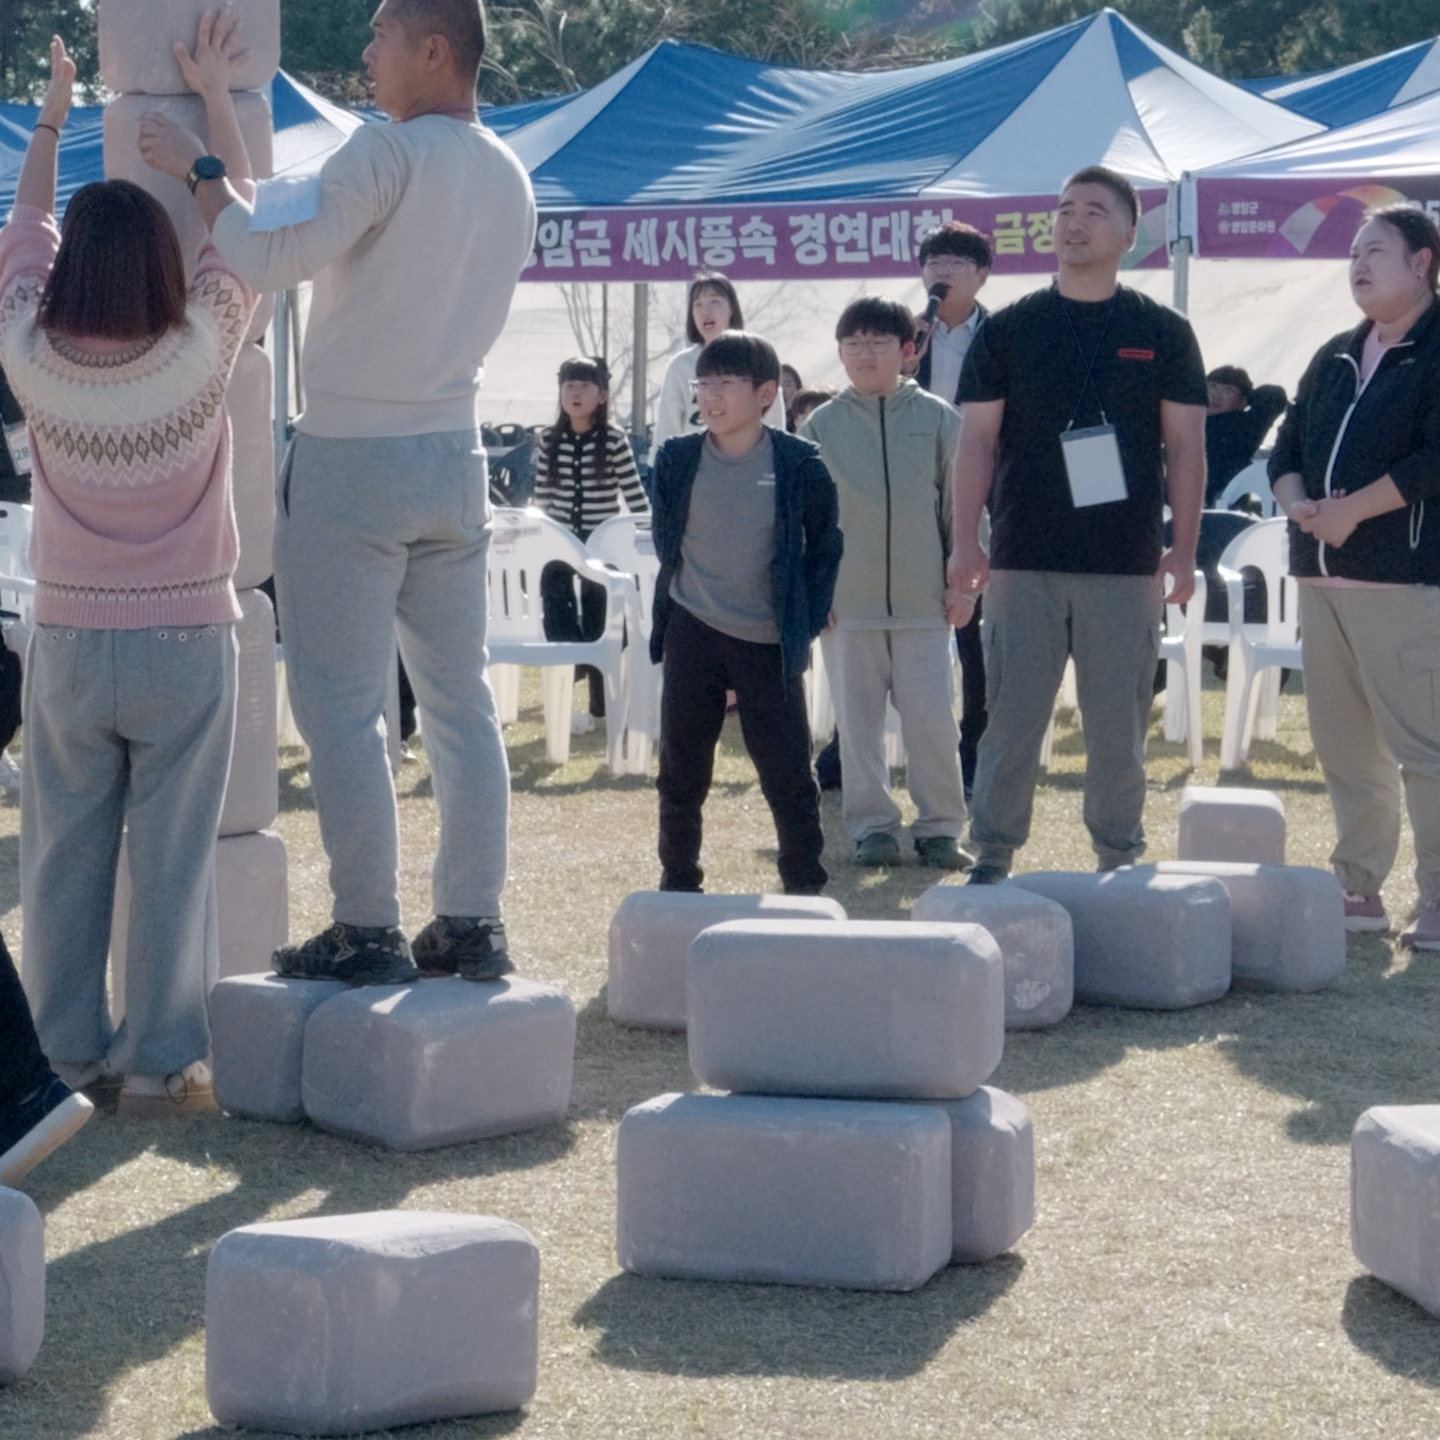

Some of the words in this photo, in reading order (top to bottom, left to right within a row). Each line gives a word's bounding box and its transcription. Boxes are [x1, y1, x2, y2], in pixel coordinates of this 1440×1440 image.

[526, 217, 612, 268] 암군
[622, 214, 777, 267] 세시풍속
[993, 211, 1056, 256] 금정
